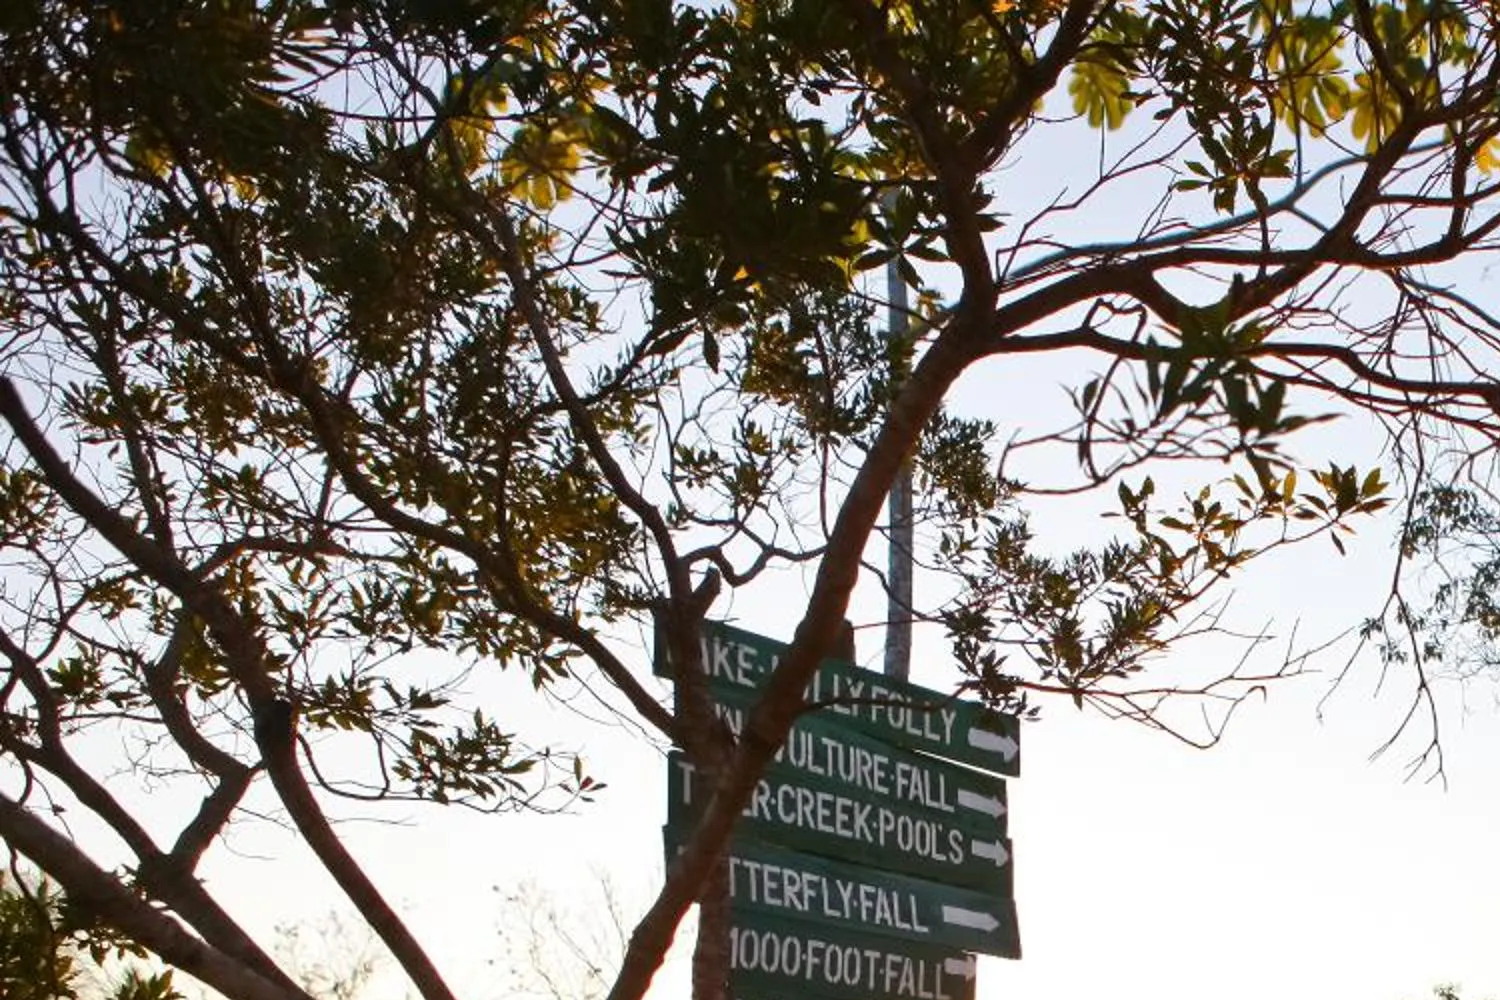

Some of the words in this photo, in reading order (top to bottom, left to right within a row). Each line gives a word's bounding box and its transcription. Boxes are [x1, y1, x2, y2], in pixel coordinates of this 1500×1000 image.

[683, 636, 758, 689] AKE
[870, 685, 957, 746] FOLLY
[777, 783, 873, 844] CREEK
[895, 761, 955, 813] FALL
[715, 855, 854, 920] TTERFLY
[859, 884, 929, 933] FALL
[729, 927, 801, 977] 1000
[805, 939, 881, 990] FOOT
[884, 951, 951, 1000] FALL
